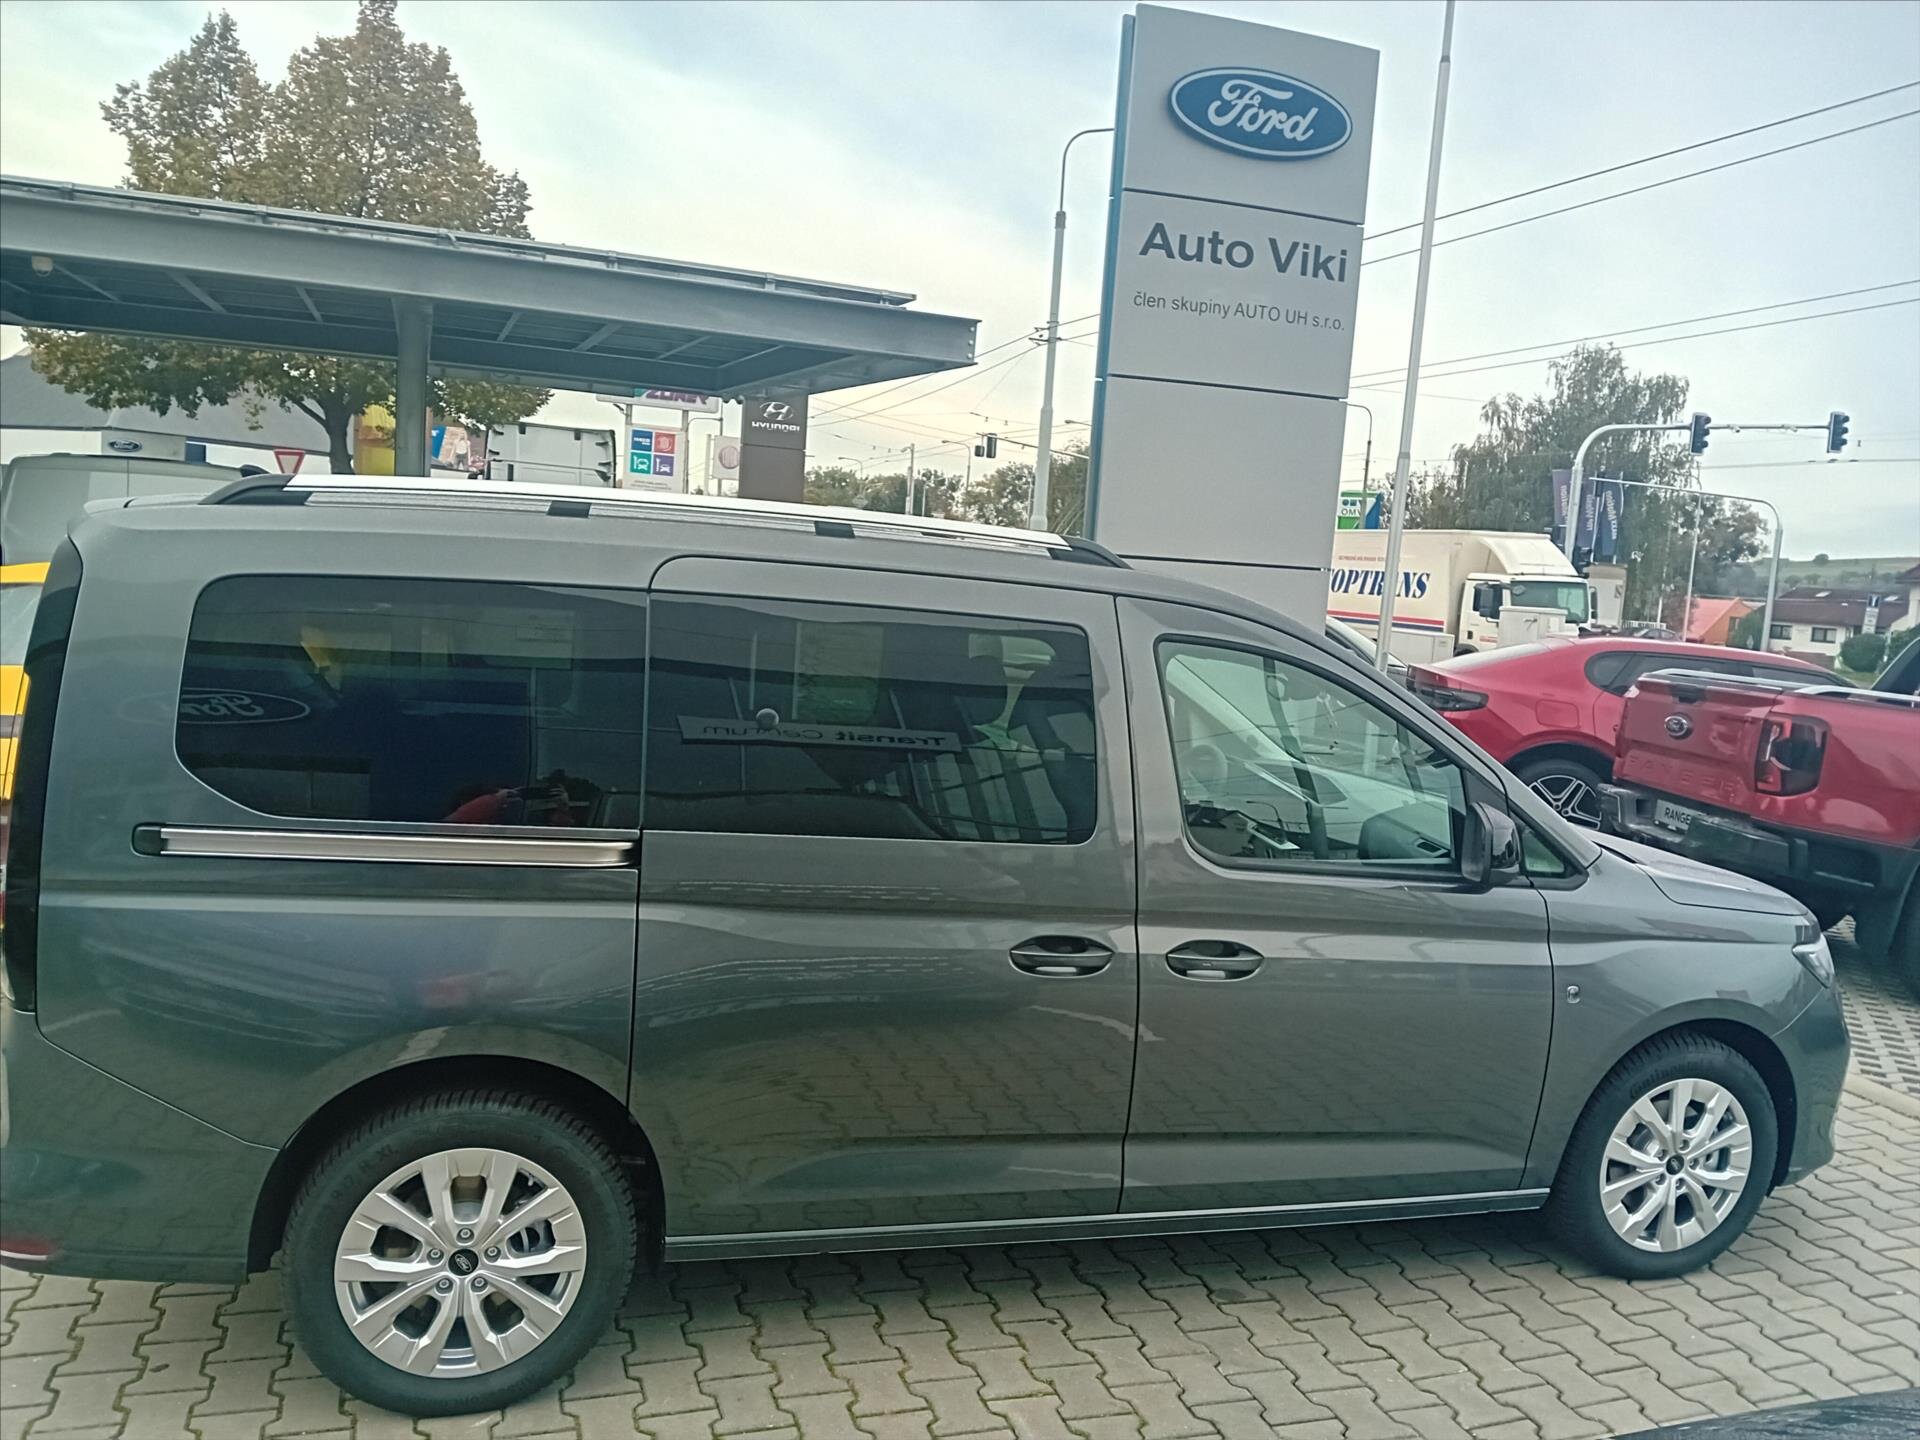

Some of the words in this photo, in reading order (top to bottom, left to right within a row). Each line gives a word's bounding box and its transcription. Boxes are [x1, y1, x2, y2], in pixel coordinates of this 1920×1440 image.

[1207, 79, 1319, 142] Ford
[1138, 222, 1254, 268] Auto
[1268, 237, 1347, 282] Viki
[1133, 291, 1166, 309] člen
[1171, 296, 1231, 319] skupiny
[1234, 302, 1280, 322] AUTO
[1285, 309, 1308, 326] UH
[1312, 315, 1345, 331] s.r.o.
[1331, 568, 1430, 599] OPTRNS
